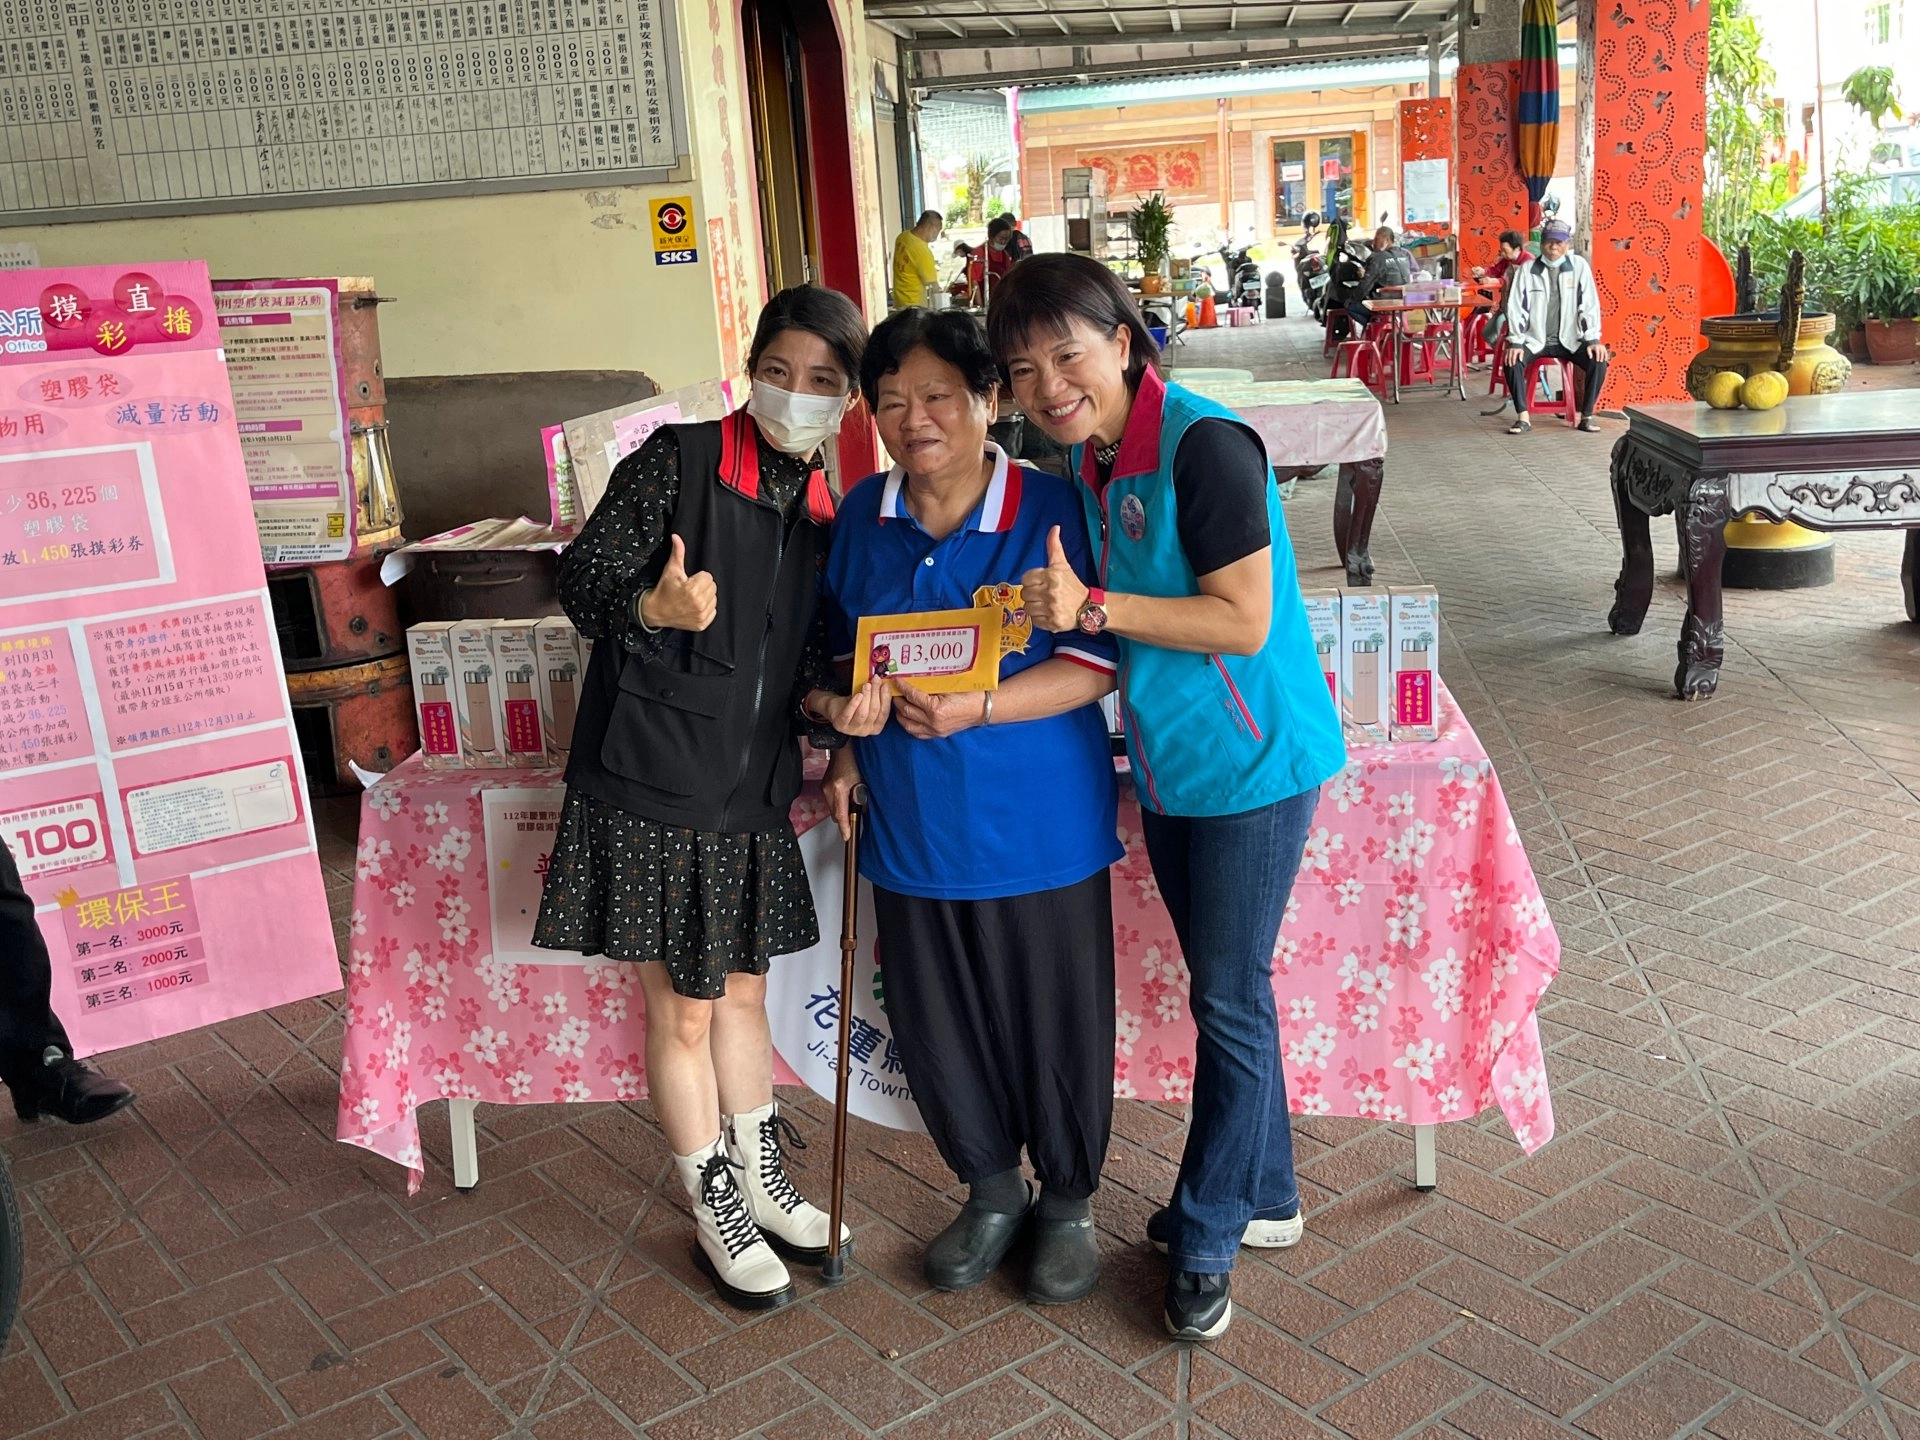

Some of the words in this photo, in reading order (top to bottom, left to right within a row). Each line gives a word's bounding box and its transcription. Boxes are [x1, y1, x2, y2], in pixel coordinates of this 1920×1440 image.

[661, 250, 692, 263] SKS
[7, 341, 46, 352] Office
[40, 373, 120, 402] 塑膠袋
[116, 402, 219, 425] 減量活動
[24, 512, 89, 539] 塑膠袋
[912, 641, 964, 664] 3,000
[75, 881, 187, 930] 環保王
[137, 920, 184, 942] 3000元
[141, 946, 189, 967] 2000元
[147, 970, 193, 992] 1000元
[807, 1040, 853, 1078] Ji-a
[859, 1069, 914, 1101] Town
